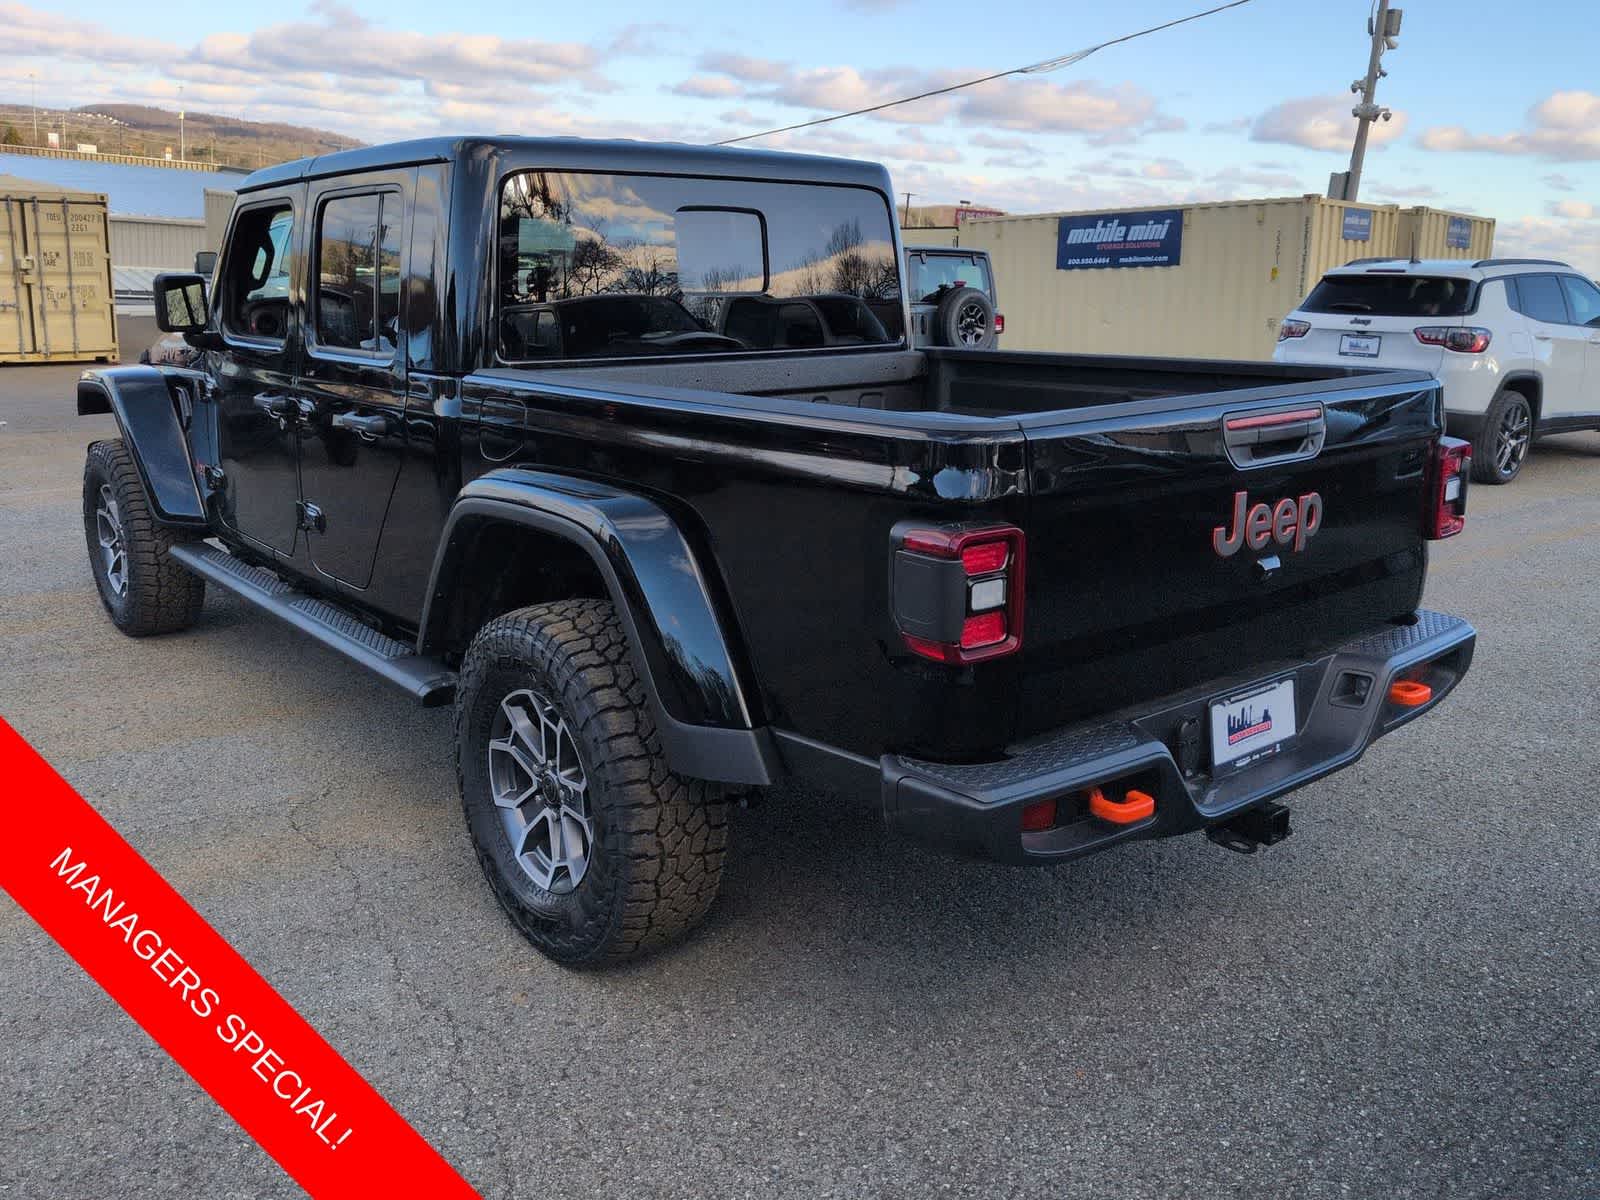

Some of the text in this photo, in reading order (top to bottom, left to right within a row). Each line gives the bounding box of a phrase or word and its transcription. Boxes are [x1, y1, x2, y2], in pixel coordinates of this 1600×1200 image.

[1066, 219, 1170, 245] mobile mini
[1213, 491, 1322, 556] Jeep
